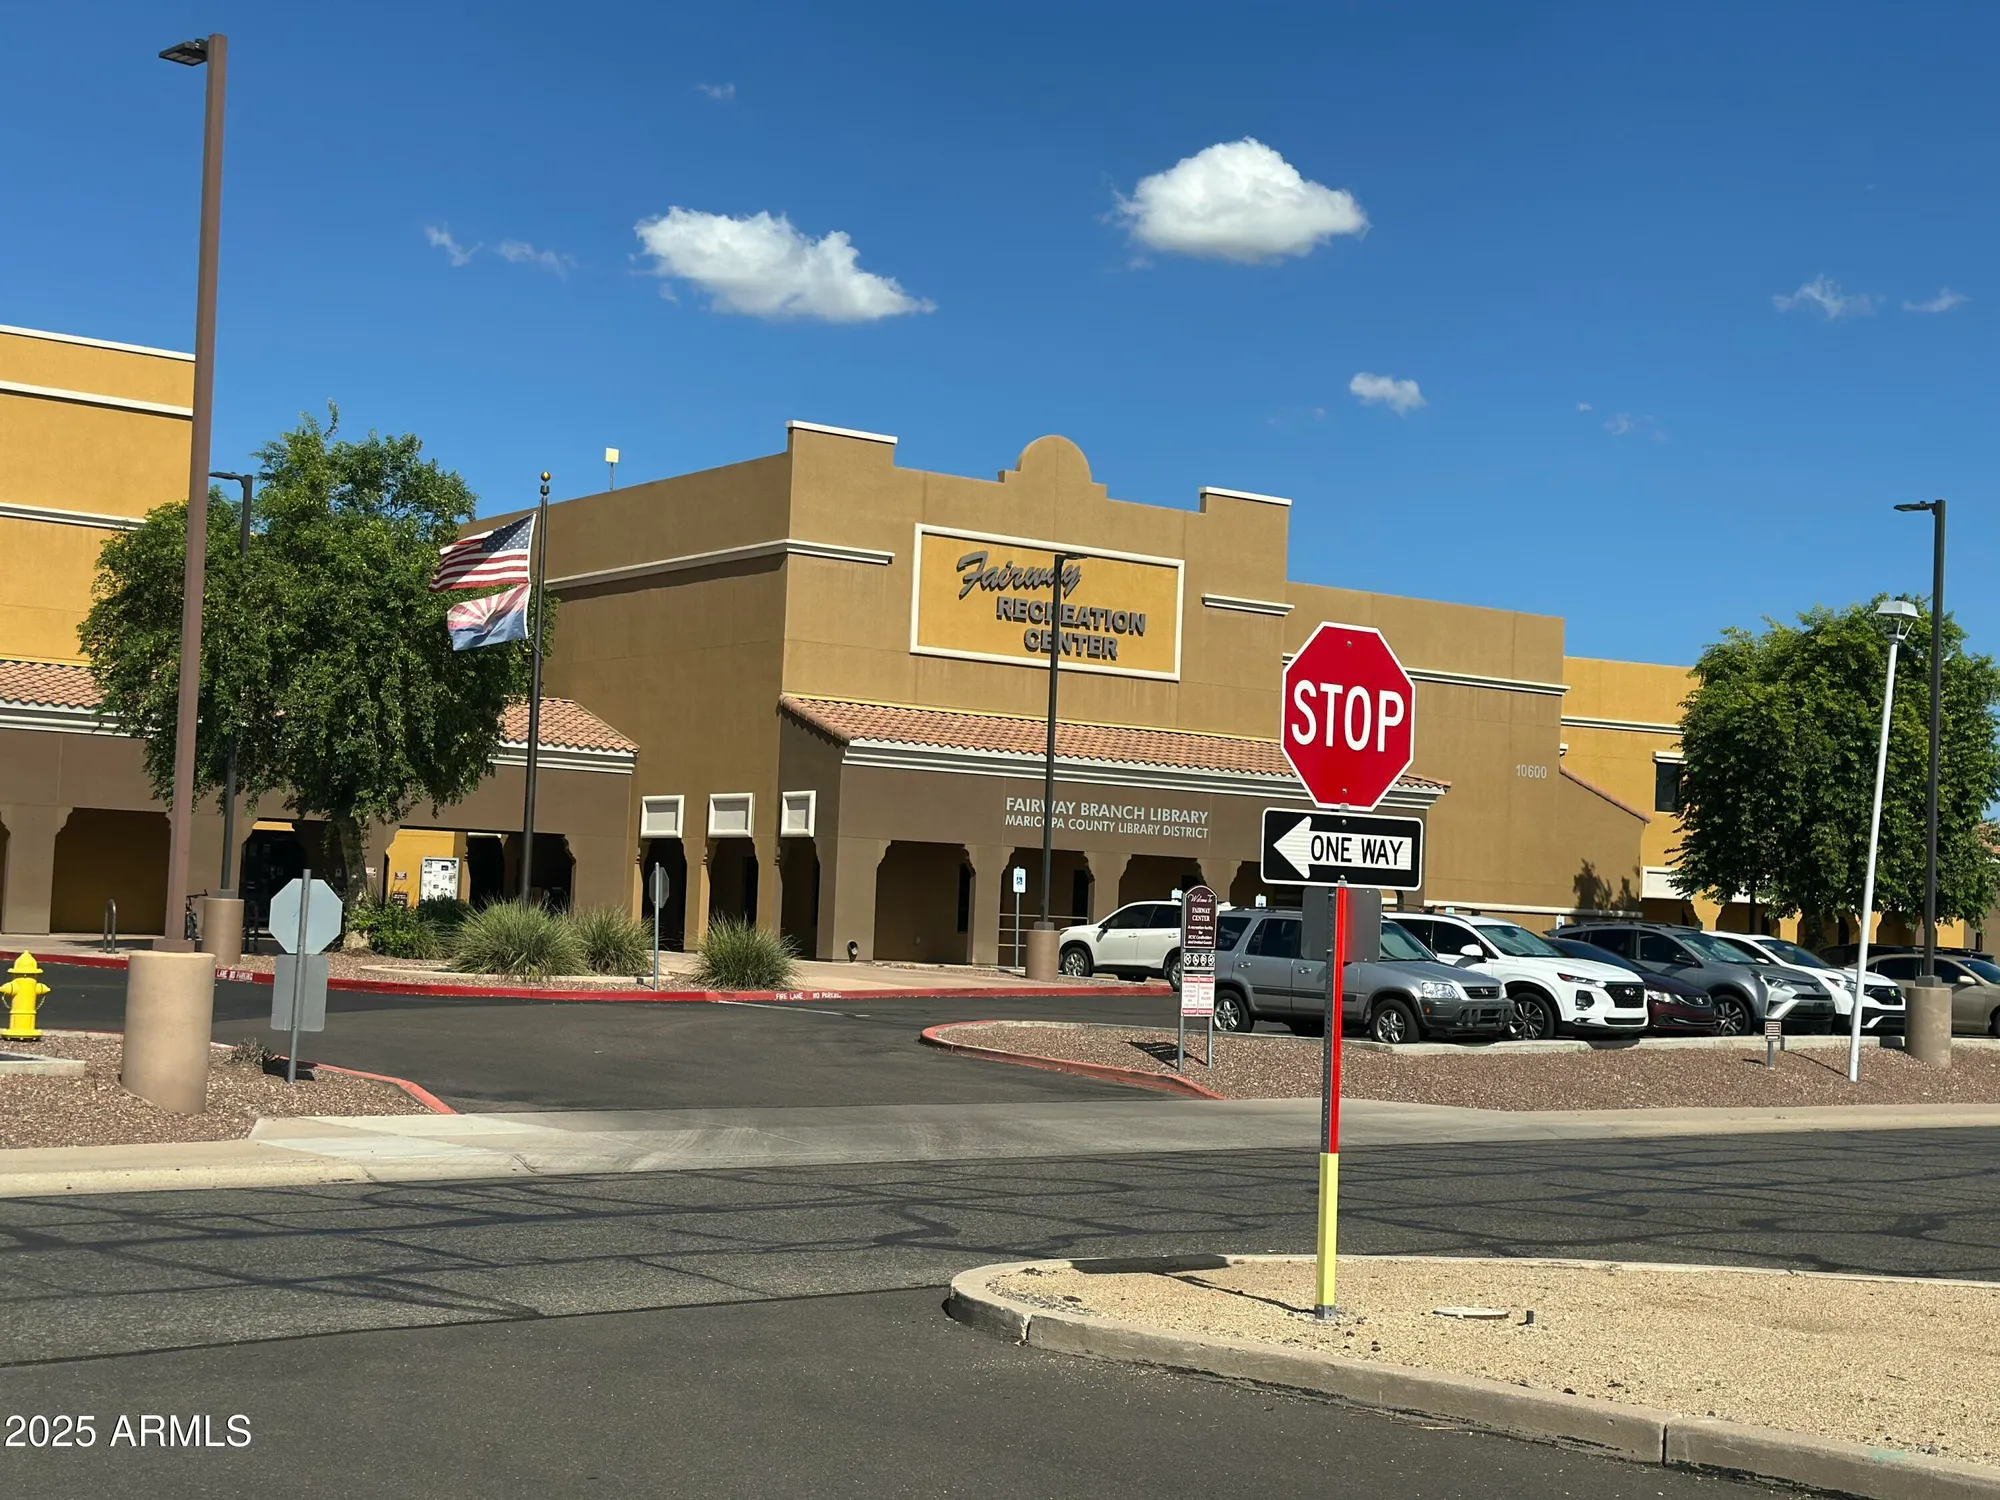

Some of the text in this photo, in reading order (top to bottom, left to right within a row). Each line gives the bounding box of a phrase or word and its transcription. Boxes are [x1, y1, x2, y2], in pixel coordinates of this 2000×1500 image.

[956, 550, 1082, 600] Fairway
[1023, 628, 1118, 660] CENTER
[1291, 679, 1405, 753] STOP
[1516, 764, 1548, 779] 10600
[1005, 814, 1208, 839] MARICPA COUNTY LIBRARY DISTRICT
[1080, 802, 1145, 820] BRANCH
[1150, 807, 1208, 825] LIBRARY
[1311, 834, 1404, 866] ONE WAY
